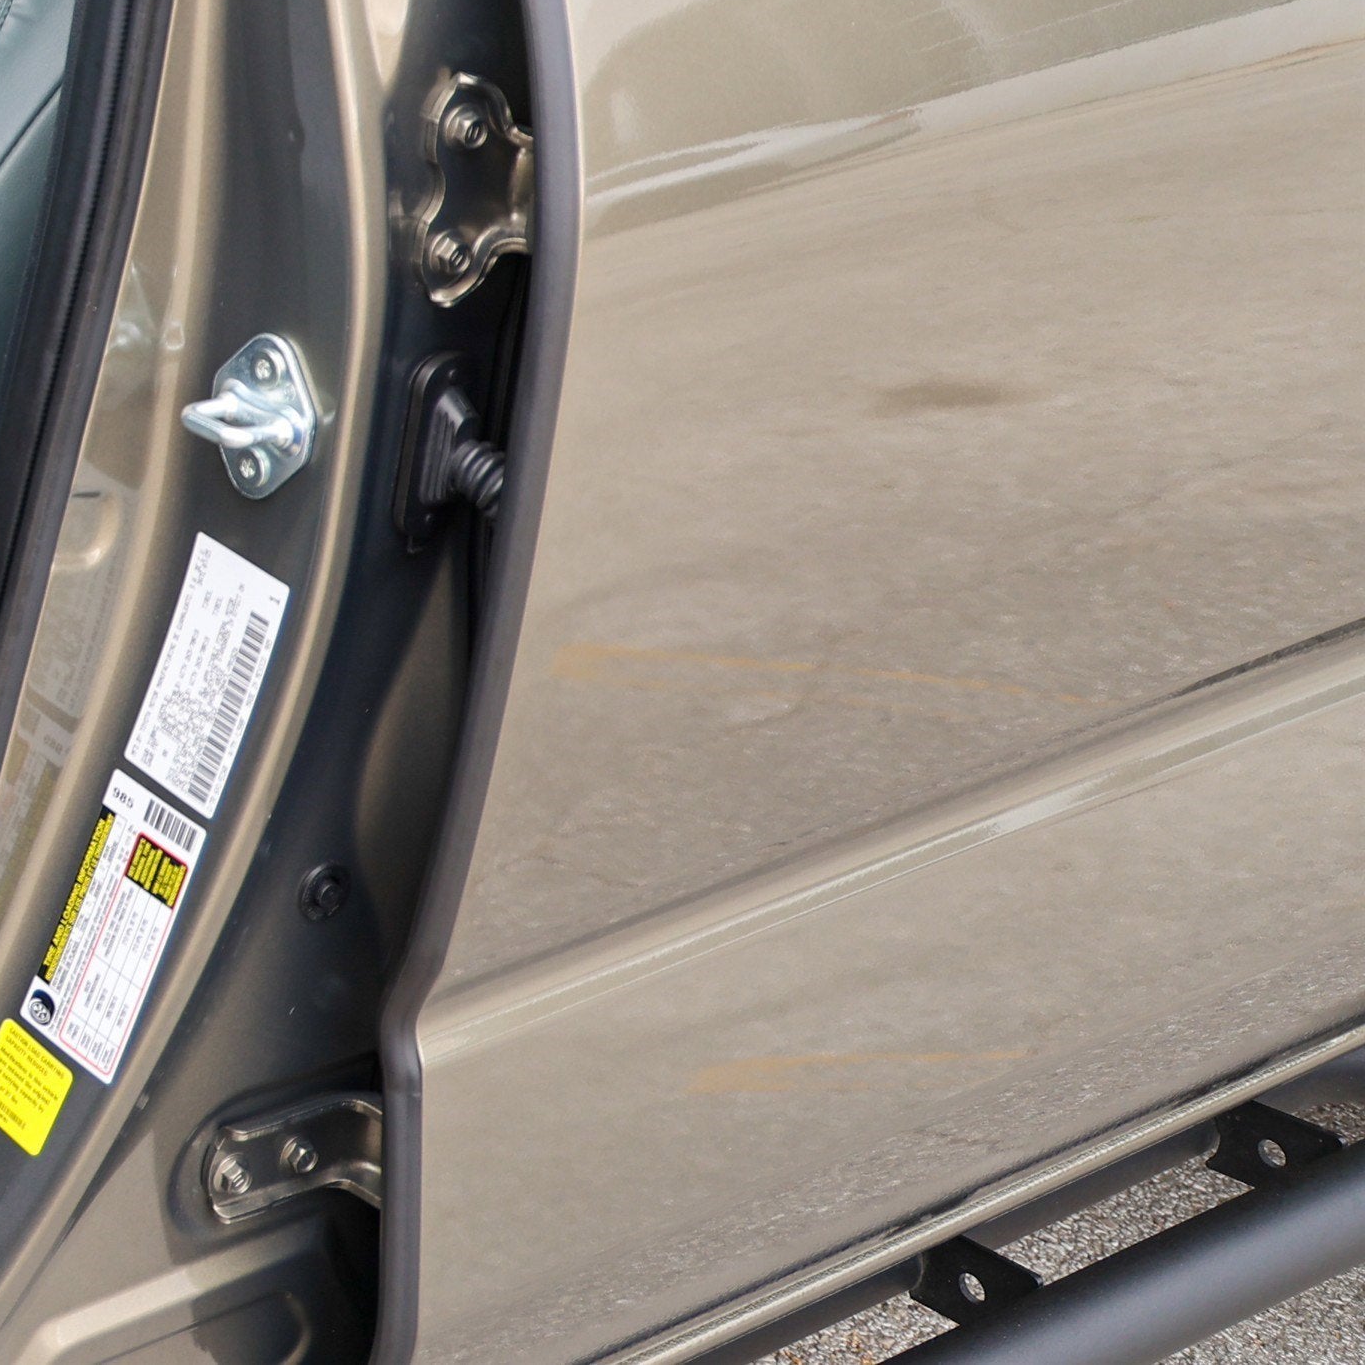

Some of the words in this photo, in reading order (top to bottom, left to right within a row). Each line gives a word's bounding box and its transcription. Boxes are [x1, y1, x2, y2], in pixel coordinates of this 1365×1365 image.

[112, 787, 134, 809] 985
[51, 923, 65, 946] AND
[59, 881, 81, 925] LOADING
